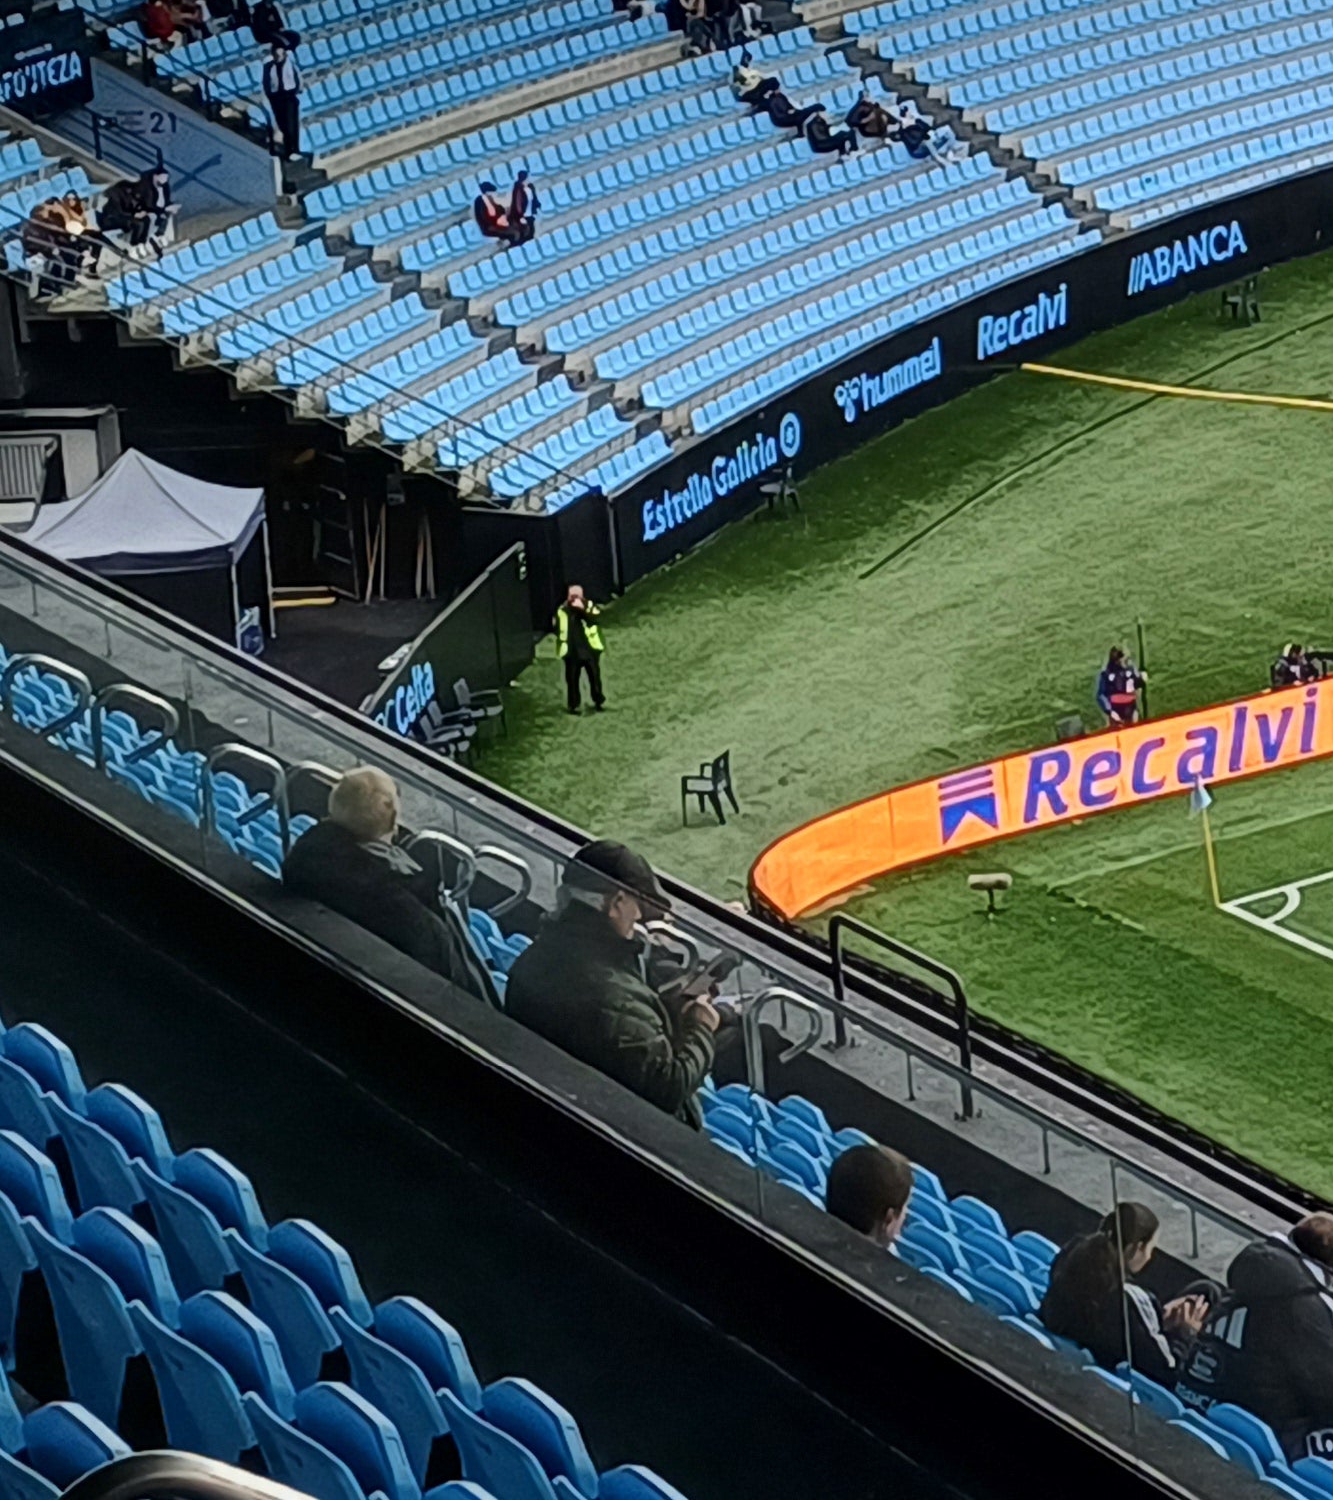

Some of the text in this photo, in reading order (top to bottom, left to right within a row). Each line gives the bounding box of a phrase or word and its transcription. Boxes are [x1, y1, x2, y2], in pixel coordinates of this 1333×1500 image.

[150, 111, 177, 134] 21
[1126, 220, 1248, 297] ABANCA
[976, 283, 1068, 361] Recalvi
[861, 336, 942, 412] hummel
[642, 432, 778, 543] Estrella Galicia
[1023, 686, 1320, 824] Recalvi
